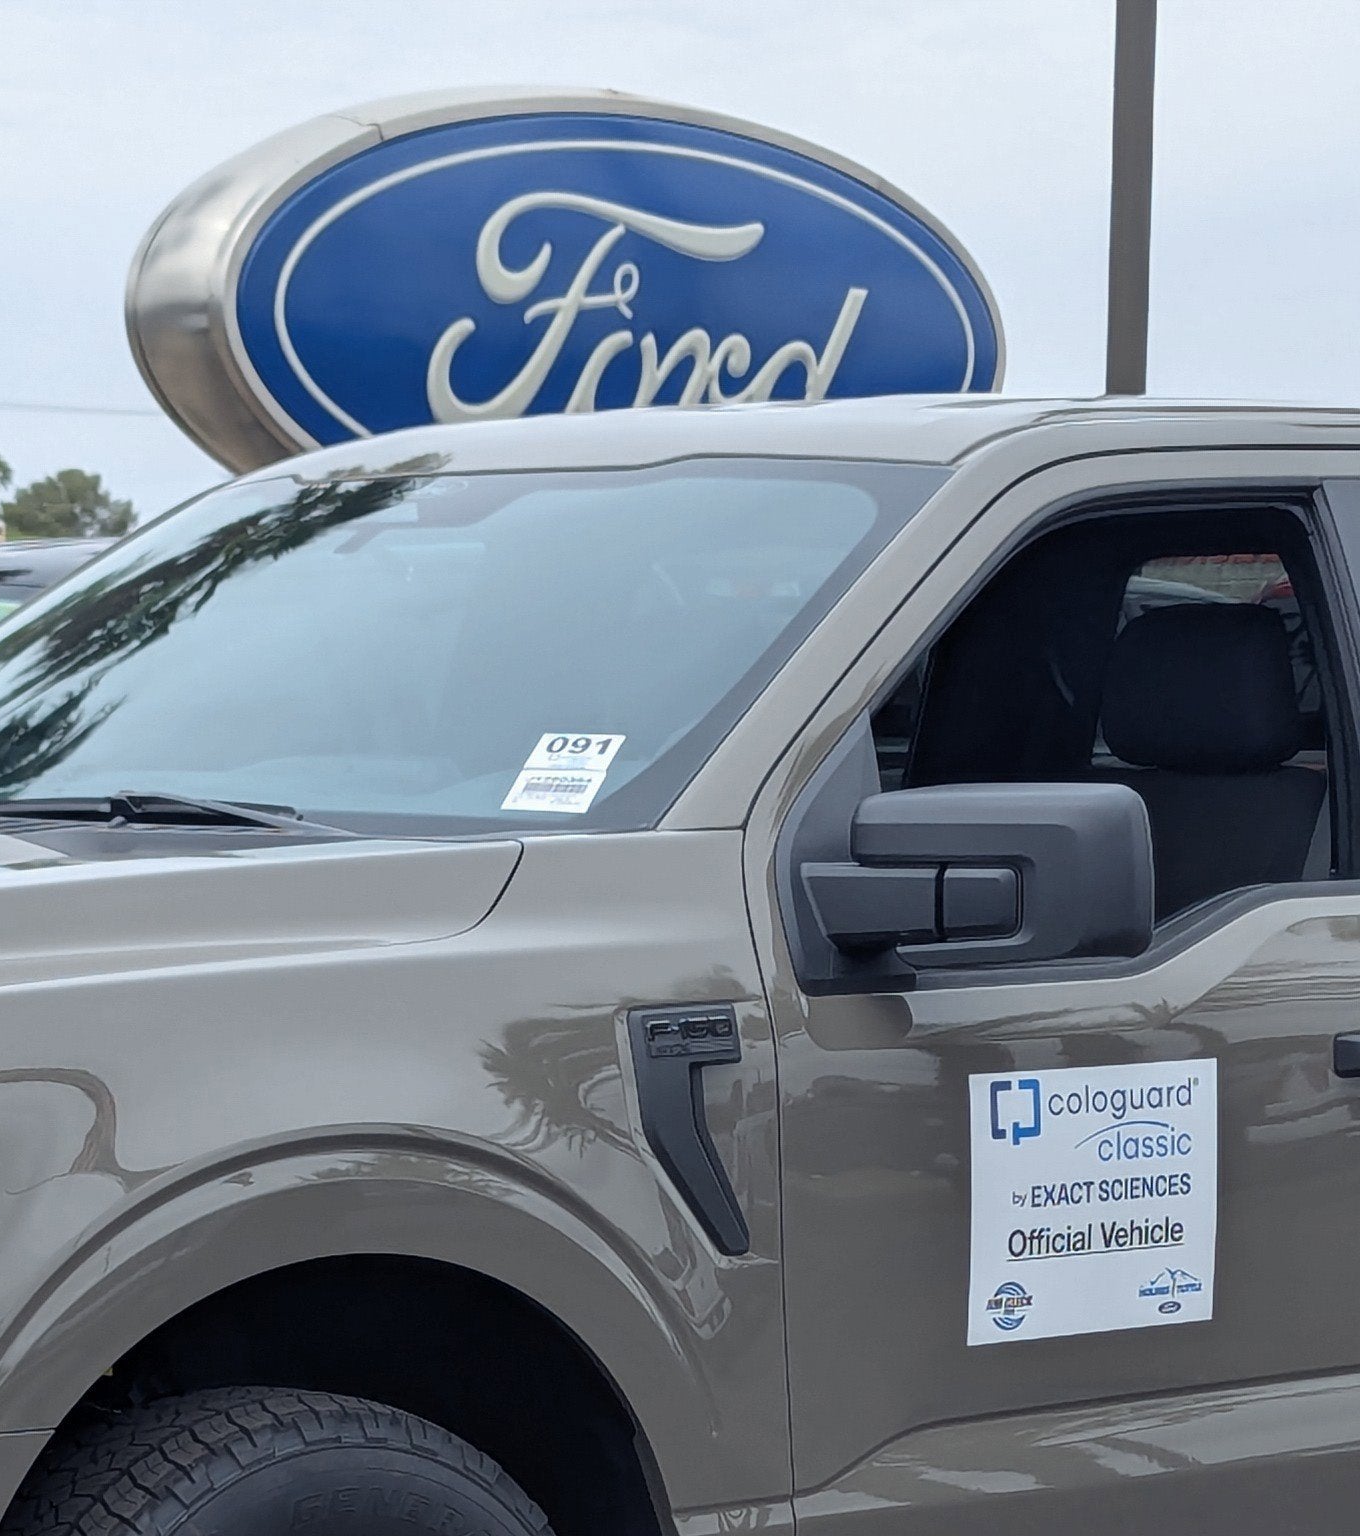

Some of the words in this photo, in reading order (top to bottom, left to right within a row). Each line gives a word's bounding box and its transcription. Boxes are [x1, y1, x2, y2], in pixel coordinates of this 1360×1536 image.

[427, 192, 869, 425] Ford
[546, 736, 613, 755] 091
[646, 1015, 734, 1042] F-150
[1098, 1126, 1193, 1162] classic
[1012, 1191, 1028, 1208] by
[1031, 1181, 1095, 1208] EXACT
[1098, 1172, 1192, 1203] SCIENCES
[1008, 1223, 1093, 1258] Official
[1100, 1216, 1185, 1249] Vehicle
